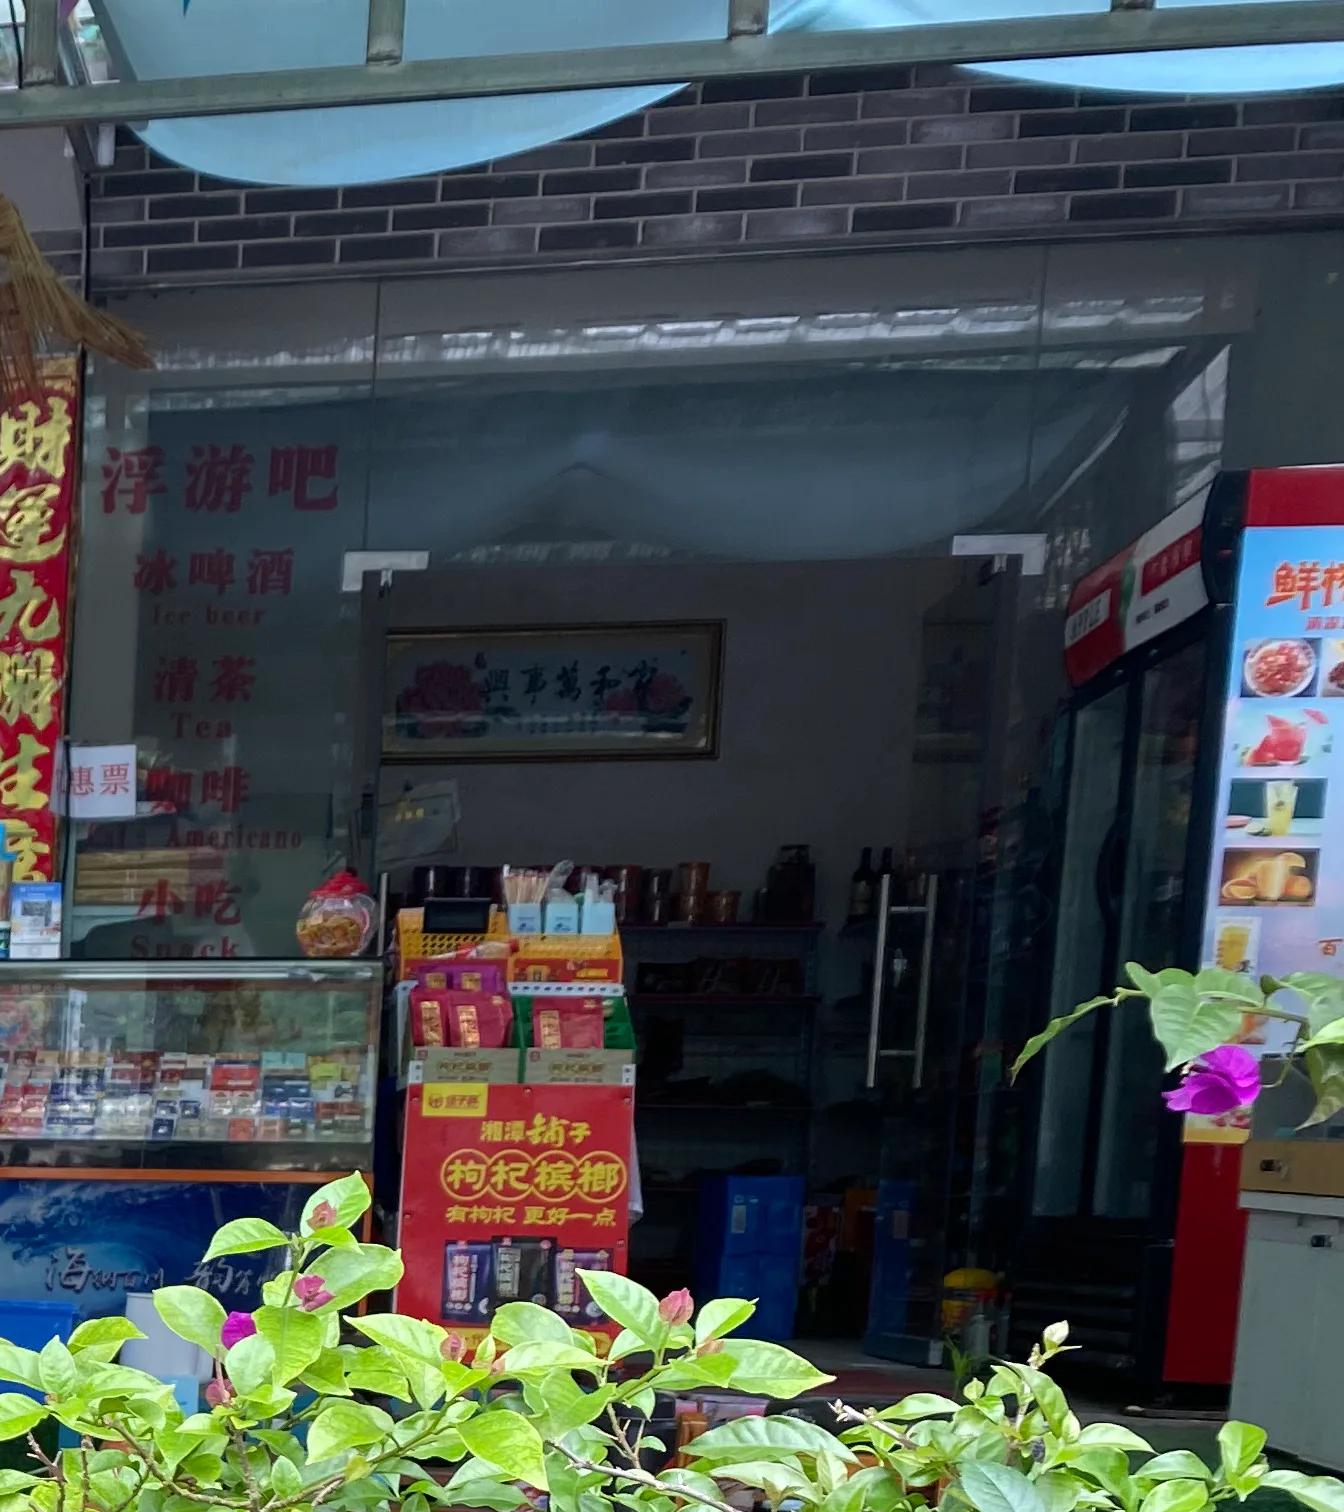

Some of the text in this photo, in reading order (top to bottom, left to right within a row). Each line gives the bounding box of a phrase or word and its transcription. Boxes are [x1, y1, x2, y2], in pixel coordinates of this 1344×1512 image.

[101, 443, 339, 514] 浮游吧
[133, 548, 294, 595] 冰啤酒
[154, 655, 256, 702] 清茶
[170, 711, 233, 740] Tea
[167, 823, 303, 849] Americano
[137, 879, 242, 926] 小吃
[130, 934, 240, 958] Snack
[480, 1112, 592, 1147] 湘潭铺子
[446, 1158, 623, 1194] 枸杞槟榔
[445, 1205, 617, 1228] 有枸杞 更好一点
